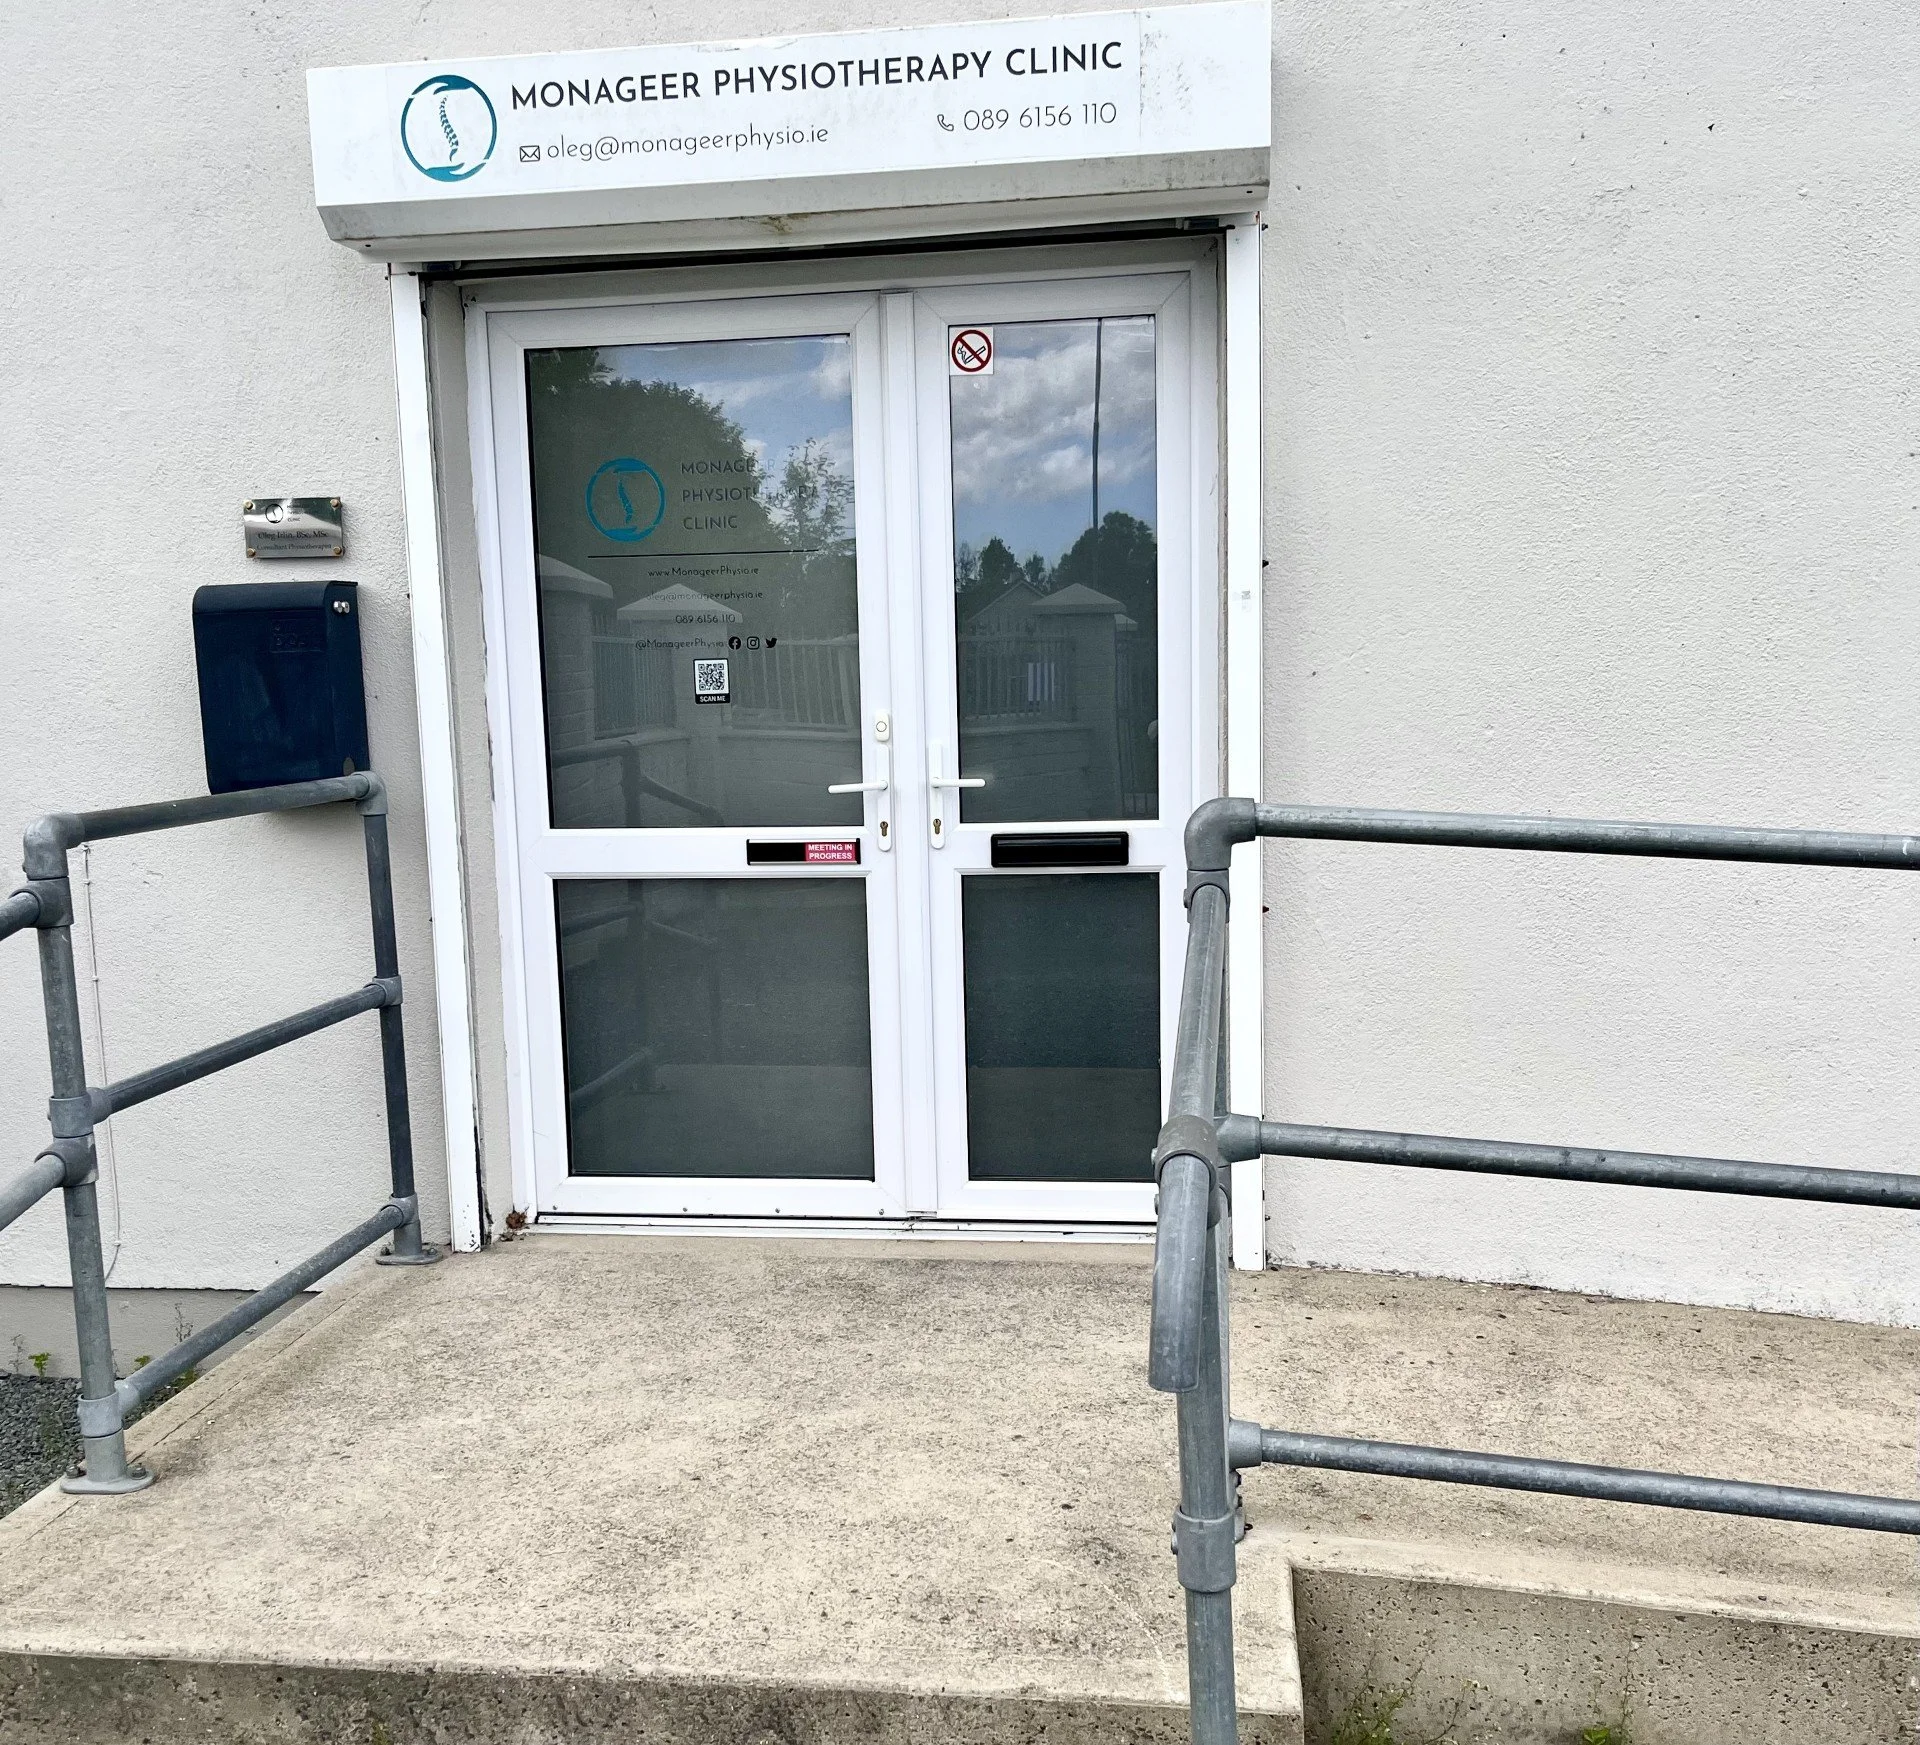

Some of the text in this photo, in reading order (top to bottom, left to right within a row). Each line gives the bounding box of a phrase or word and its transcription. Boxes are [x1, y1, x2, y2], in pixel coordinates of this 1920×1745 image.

[512, 41, 1123, 111] MONAGEER PHYSIOTHERAPY CLINIC
[963, 102, 1117, 132] 089 6156 110
[546, 123, 829, 163] oleg@monageerphysio.ie
[683, 515, 738, 531] CLINIC
[675, 613, 736, 624] 089 6156 110
[635, 637, 725, 651] @MonageerPhysio
[699, 695, 717, 703] SCAN
[808, 843, 853, 851] MEETING IN
[808, 852, 853, 860] PROGRESS
